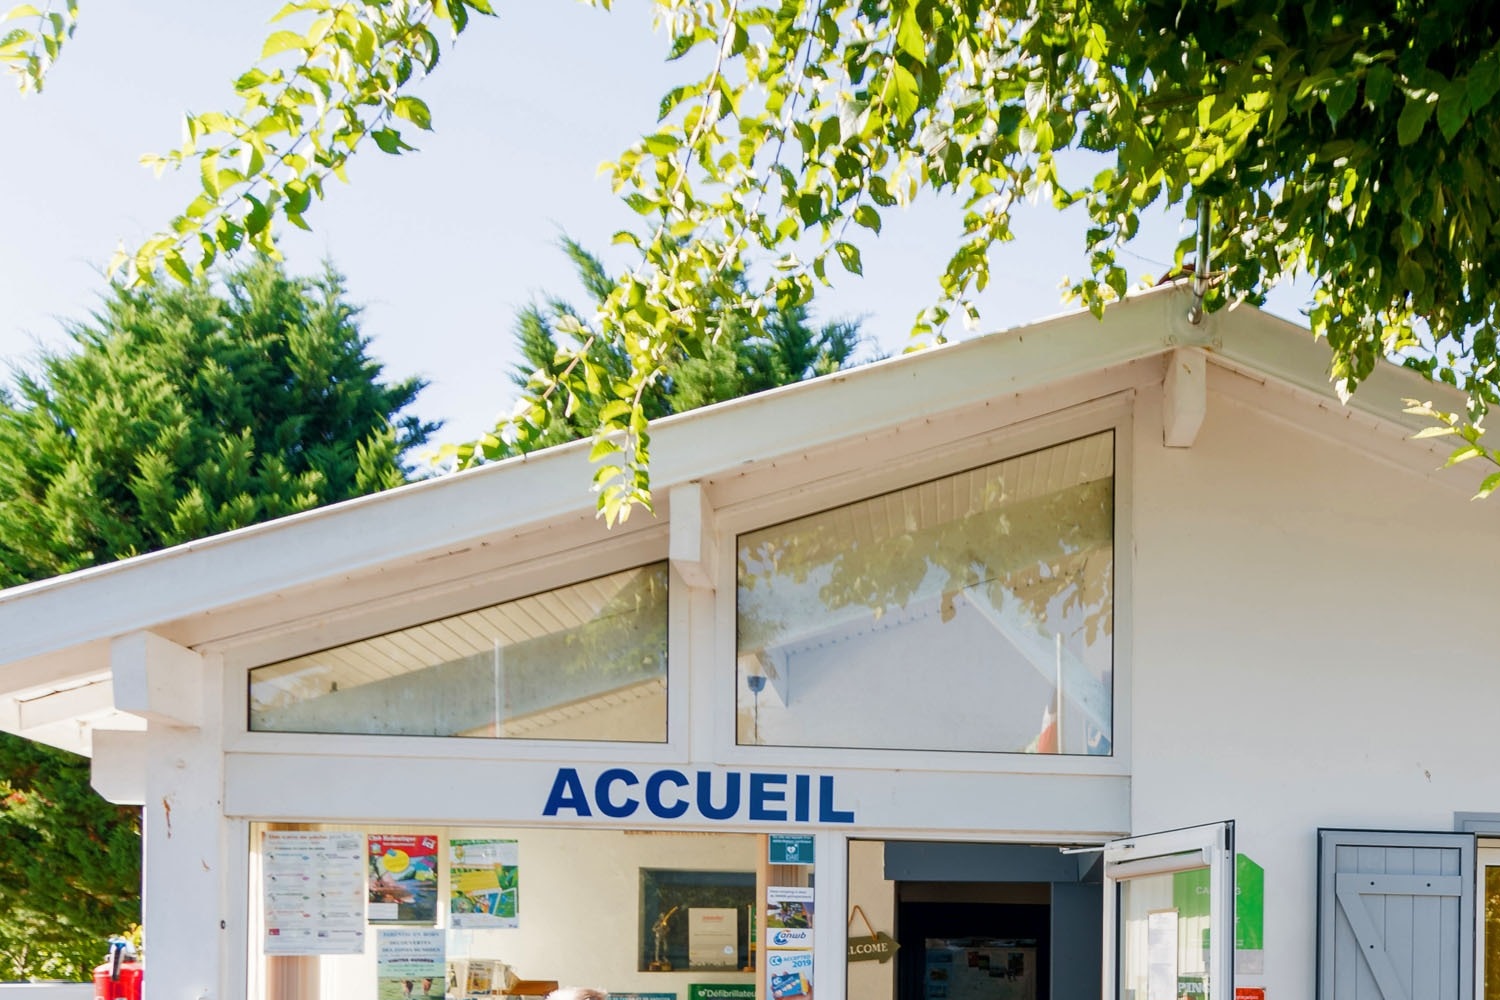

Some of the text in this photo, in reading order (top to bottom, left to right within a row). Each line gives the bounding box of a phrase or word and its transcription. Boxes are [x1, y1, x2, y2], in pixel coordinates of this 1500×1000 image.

[543, 767, 855, 823] ACCUEIL
[780, 931, 806, 939] anwb
[848, 943, 888, 955] LCOME
[793, 959, 811, 968] 2019
[706, 989, 756, 998] Défibrillateu
